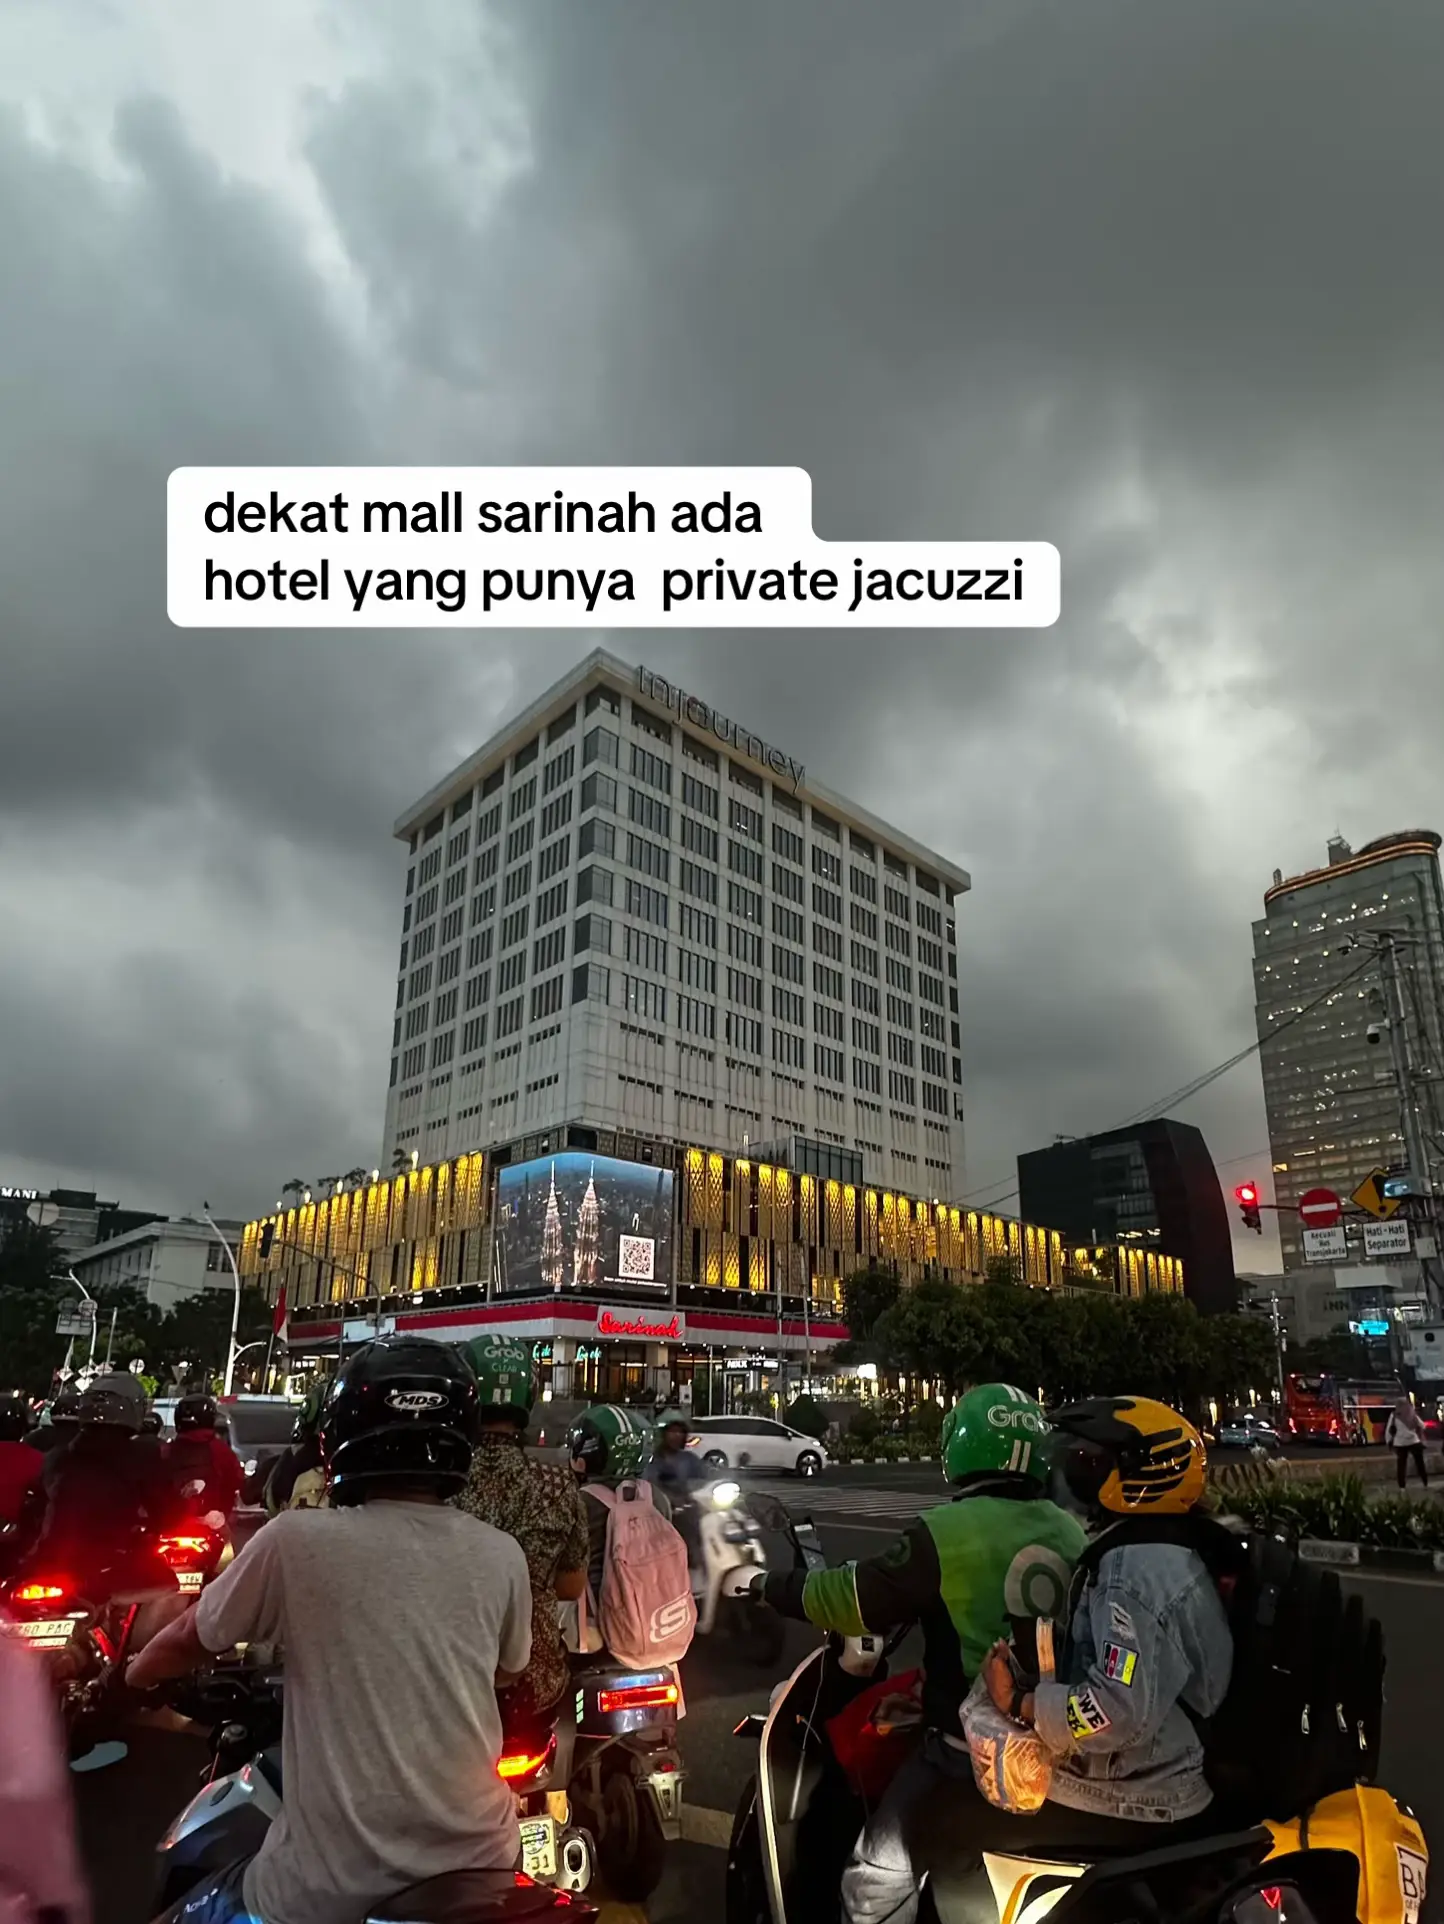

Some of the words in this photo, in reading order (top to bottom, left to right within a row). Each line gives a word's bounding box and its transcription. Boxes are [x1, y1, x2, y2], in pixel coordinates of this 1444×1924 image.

[1366, 1225, 1382, 1236] Hati
[1388, 1224, 1405, 1235] Hati
[1367, 1237, 1406, 1250] Separator
[598, 1311, 684, 1340] Sarinah
[483, 1345, 525, 1361] Grab
[398, 1394, 443, 1407] MDS
[987, 1404, 1052, 1437] Grab
[614, 1433, 642, 1447] Grab
